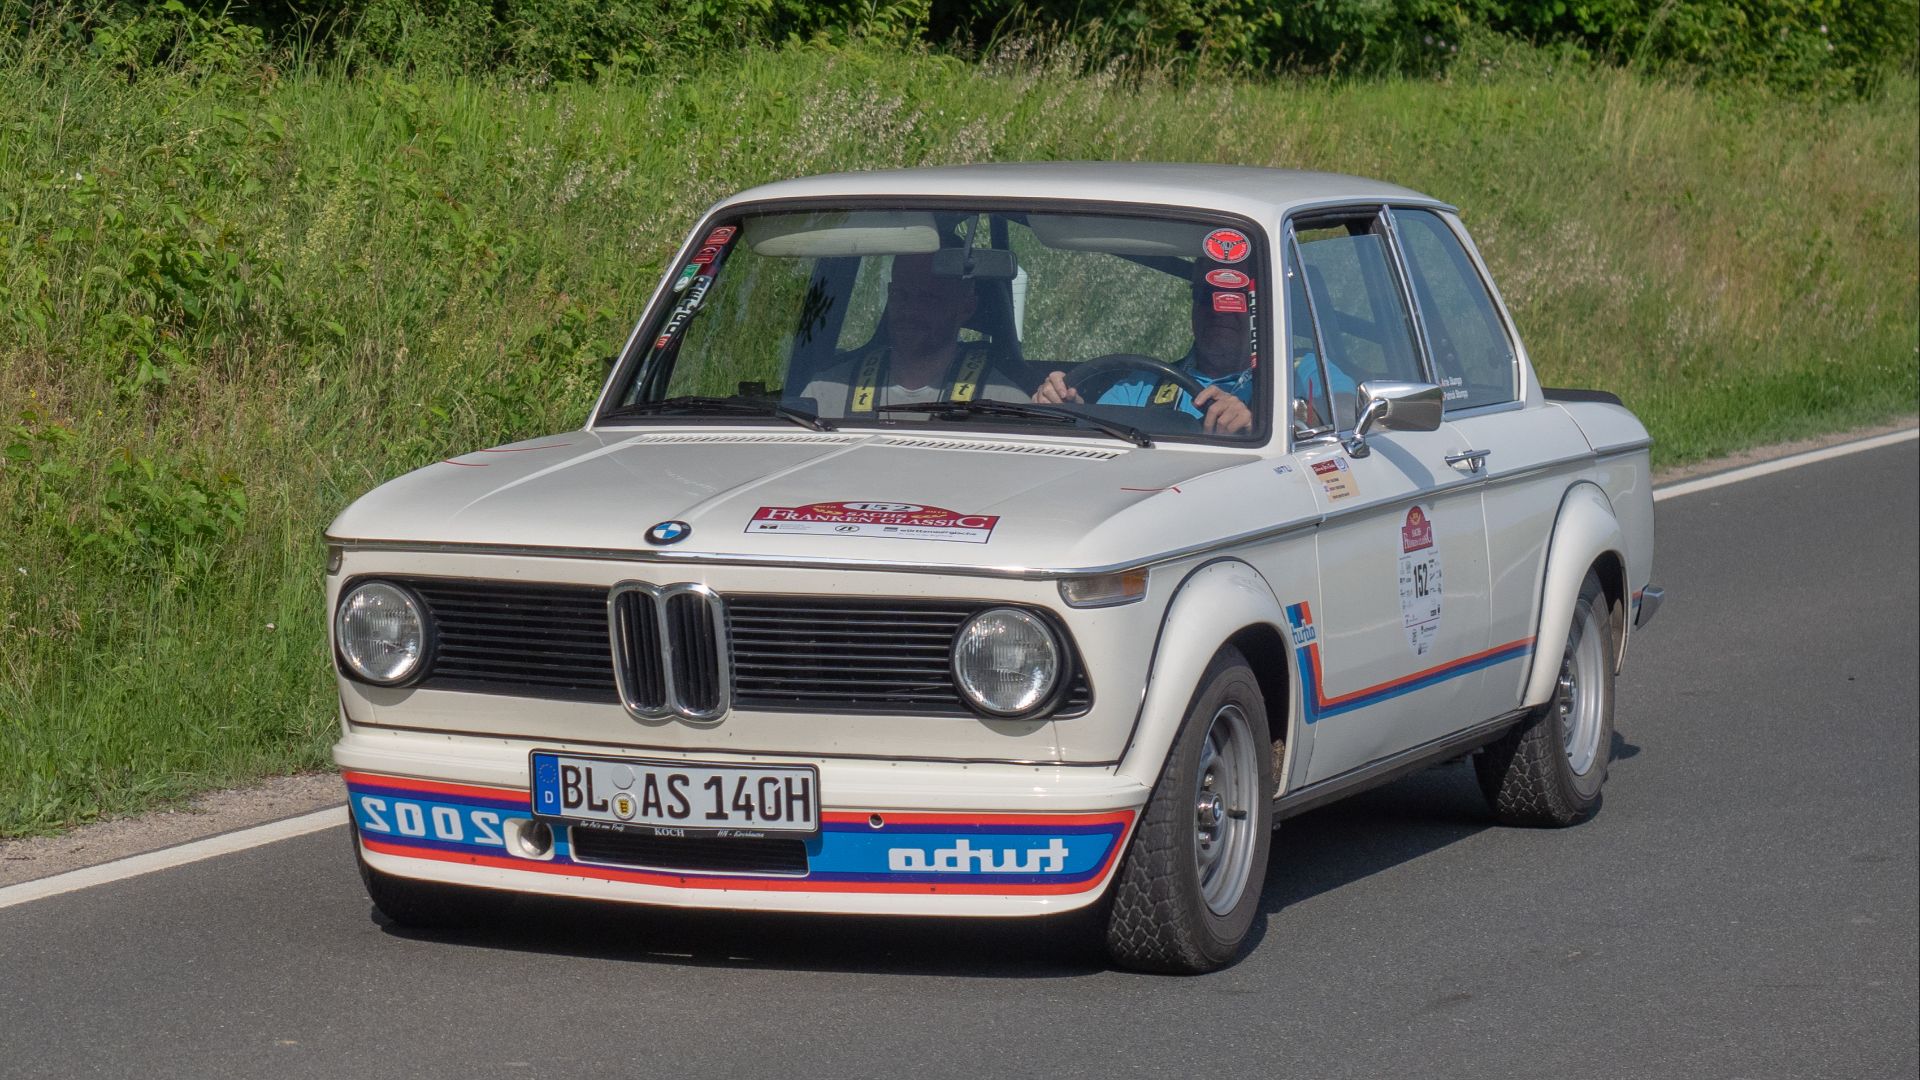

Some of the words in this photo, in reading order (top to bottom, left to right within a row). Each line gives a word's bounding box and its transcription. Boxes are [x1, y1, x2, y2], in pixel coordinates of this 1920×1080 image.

[845, 511, 908, 519] SACHS
[857, 503, 911, 512] 152
[764, 508, 873, 523] FRANKEN
[880, 515, 989, 528] CLASSIC
[1413, 562, 1429, 599] 152
[1291, 619, 1316, 645] turbo
[544, 790, 554, 804] D
[560, 764, 610, 813] BL
[641, 772, 692, 819] AS
[703, 775, 812, 823] 140H
[653, 827, 685, 838] KOCH
